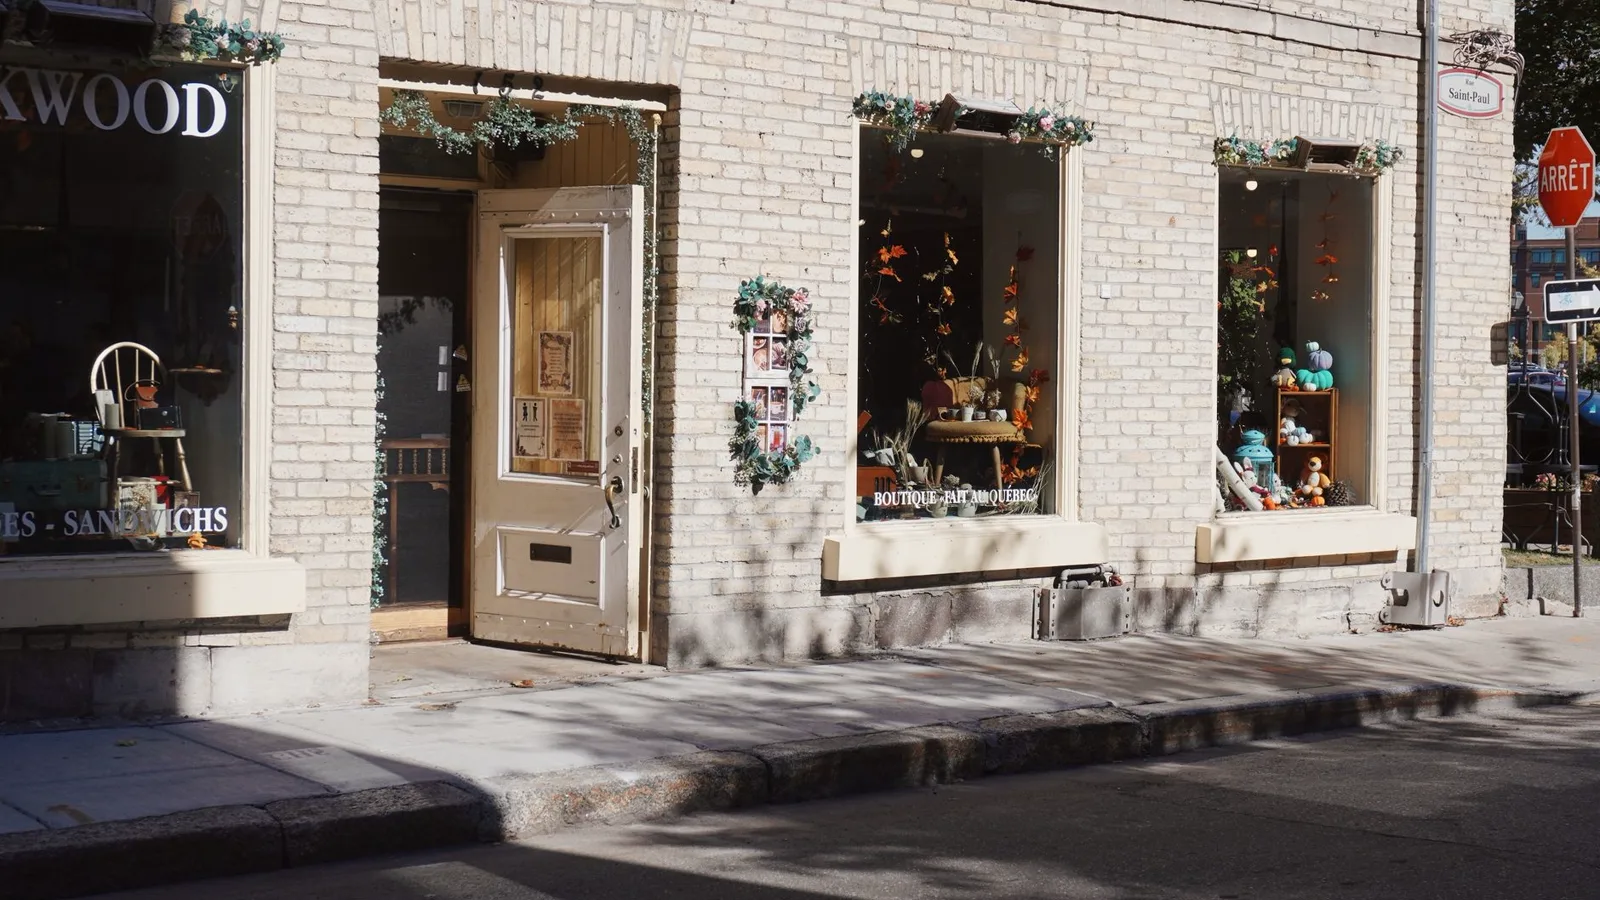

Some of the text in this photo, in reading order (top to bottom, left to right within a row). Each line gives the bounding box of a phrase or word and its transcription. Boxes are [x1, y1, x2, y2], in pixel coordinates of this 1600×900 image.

[1448, 87, 1490, 104] Saint-Paul
[1540, 158, 1591, 192] ARRÊT
[873, 490, 938, 509] BOUTIQUE
[971, 489, 987, 504] AU
[0, 511, 36, 537] ES
[63, 506, 228, 537] SANDWICHS
